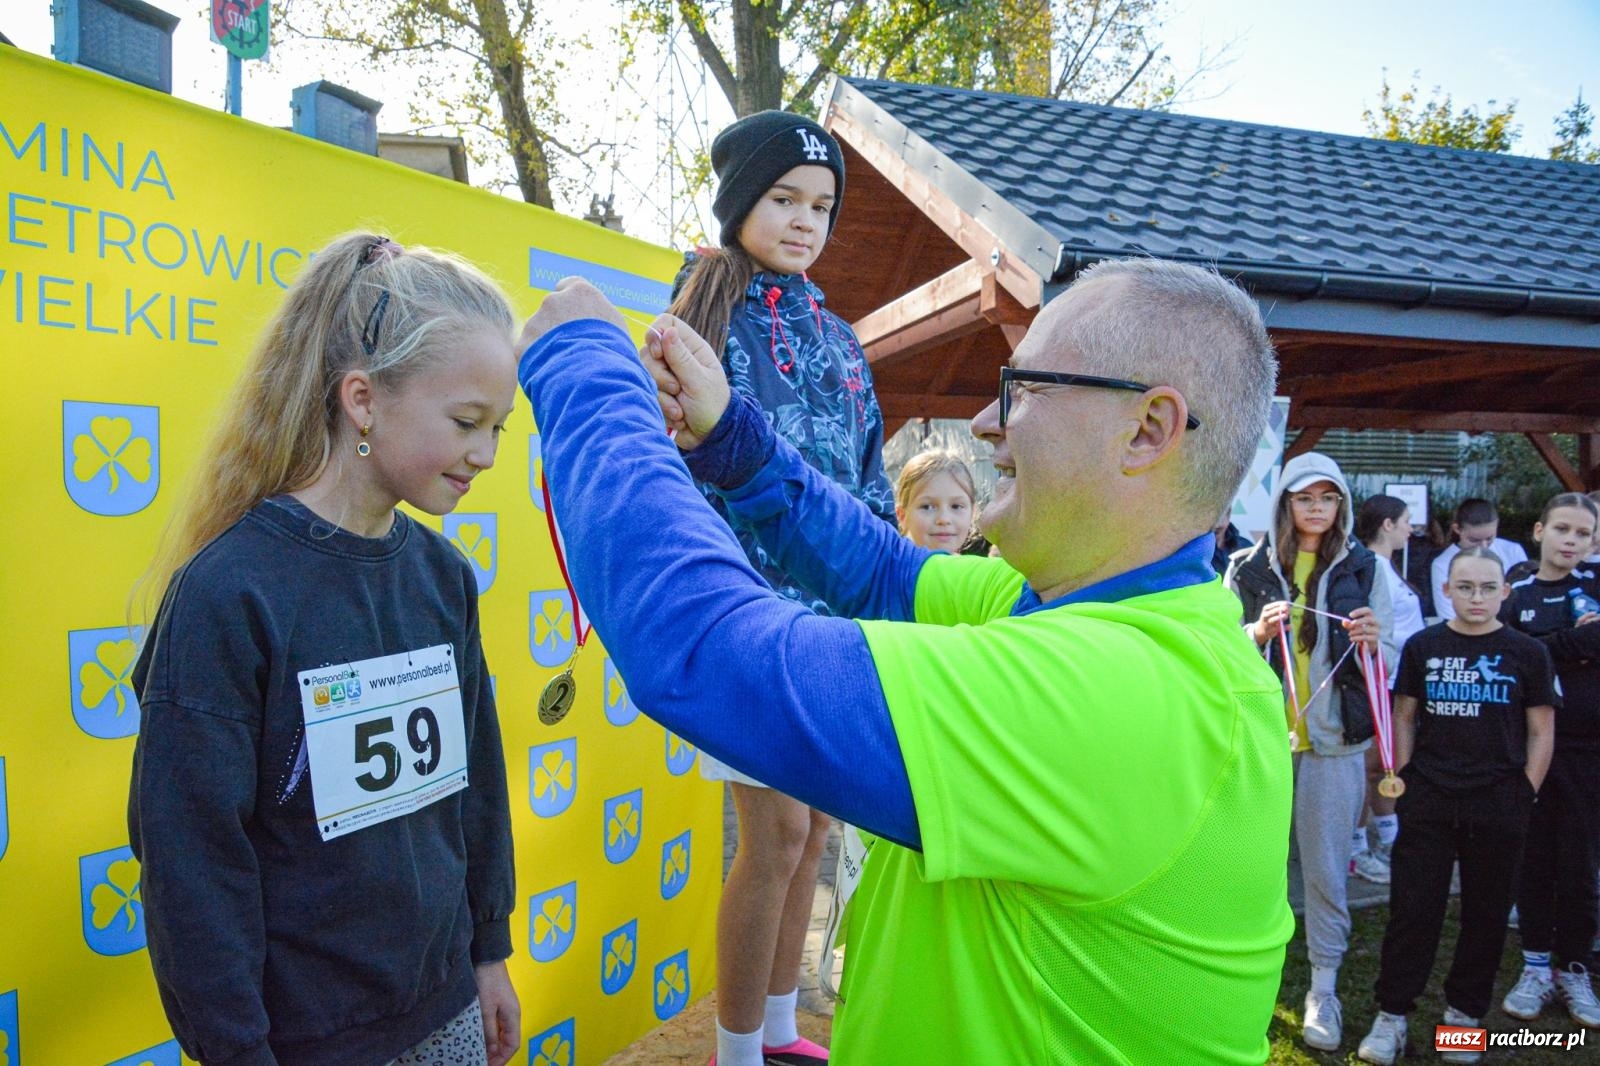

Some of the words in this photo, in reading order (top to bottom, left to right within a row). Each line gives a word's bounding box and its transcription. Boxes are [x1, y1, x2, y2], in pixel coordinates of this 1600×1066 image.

[227, 9, 257, 34] START
[796, 128, 828, 160] LA
[0, 120, 176, 200] MINA
[8, 192, 318, 289] ETROWIC
[0, 269, 219, 346] IELKIE
[1520, 609, 1536, 622] AP
[369, 660, 452, 690] www.personalbest.pl
[1442, 670, 1480, 683] SLEEP
[1444, 657, 1467, 670] EAT
[550, 683, 569, 712] 2
[1426, 682, 1510, 704] HANDBALL
[1436, 701, 1481, 716] REPEAT
[354, 706, 441, 792] 59
[844, 850, 859, 880] est.pl
